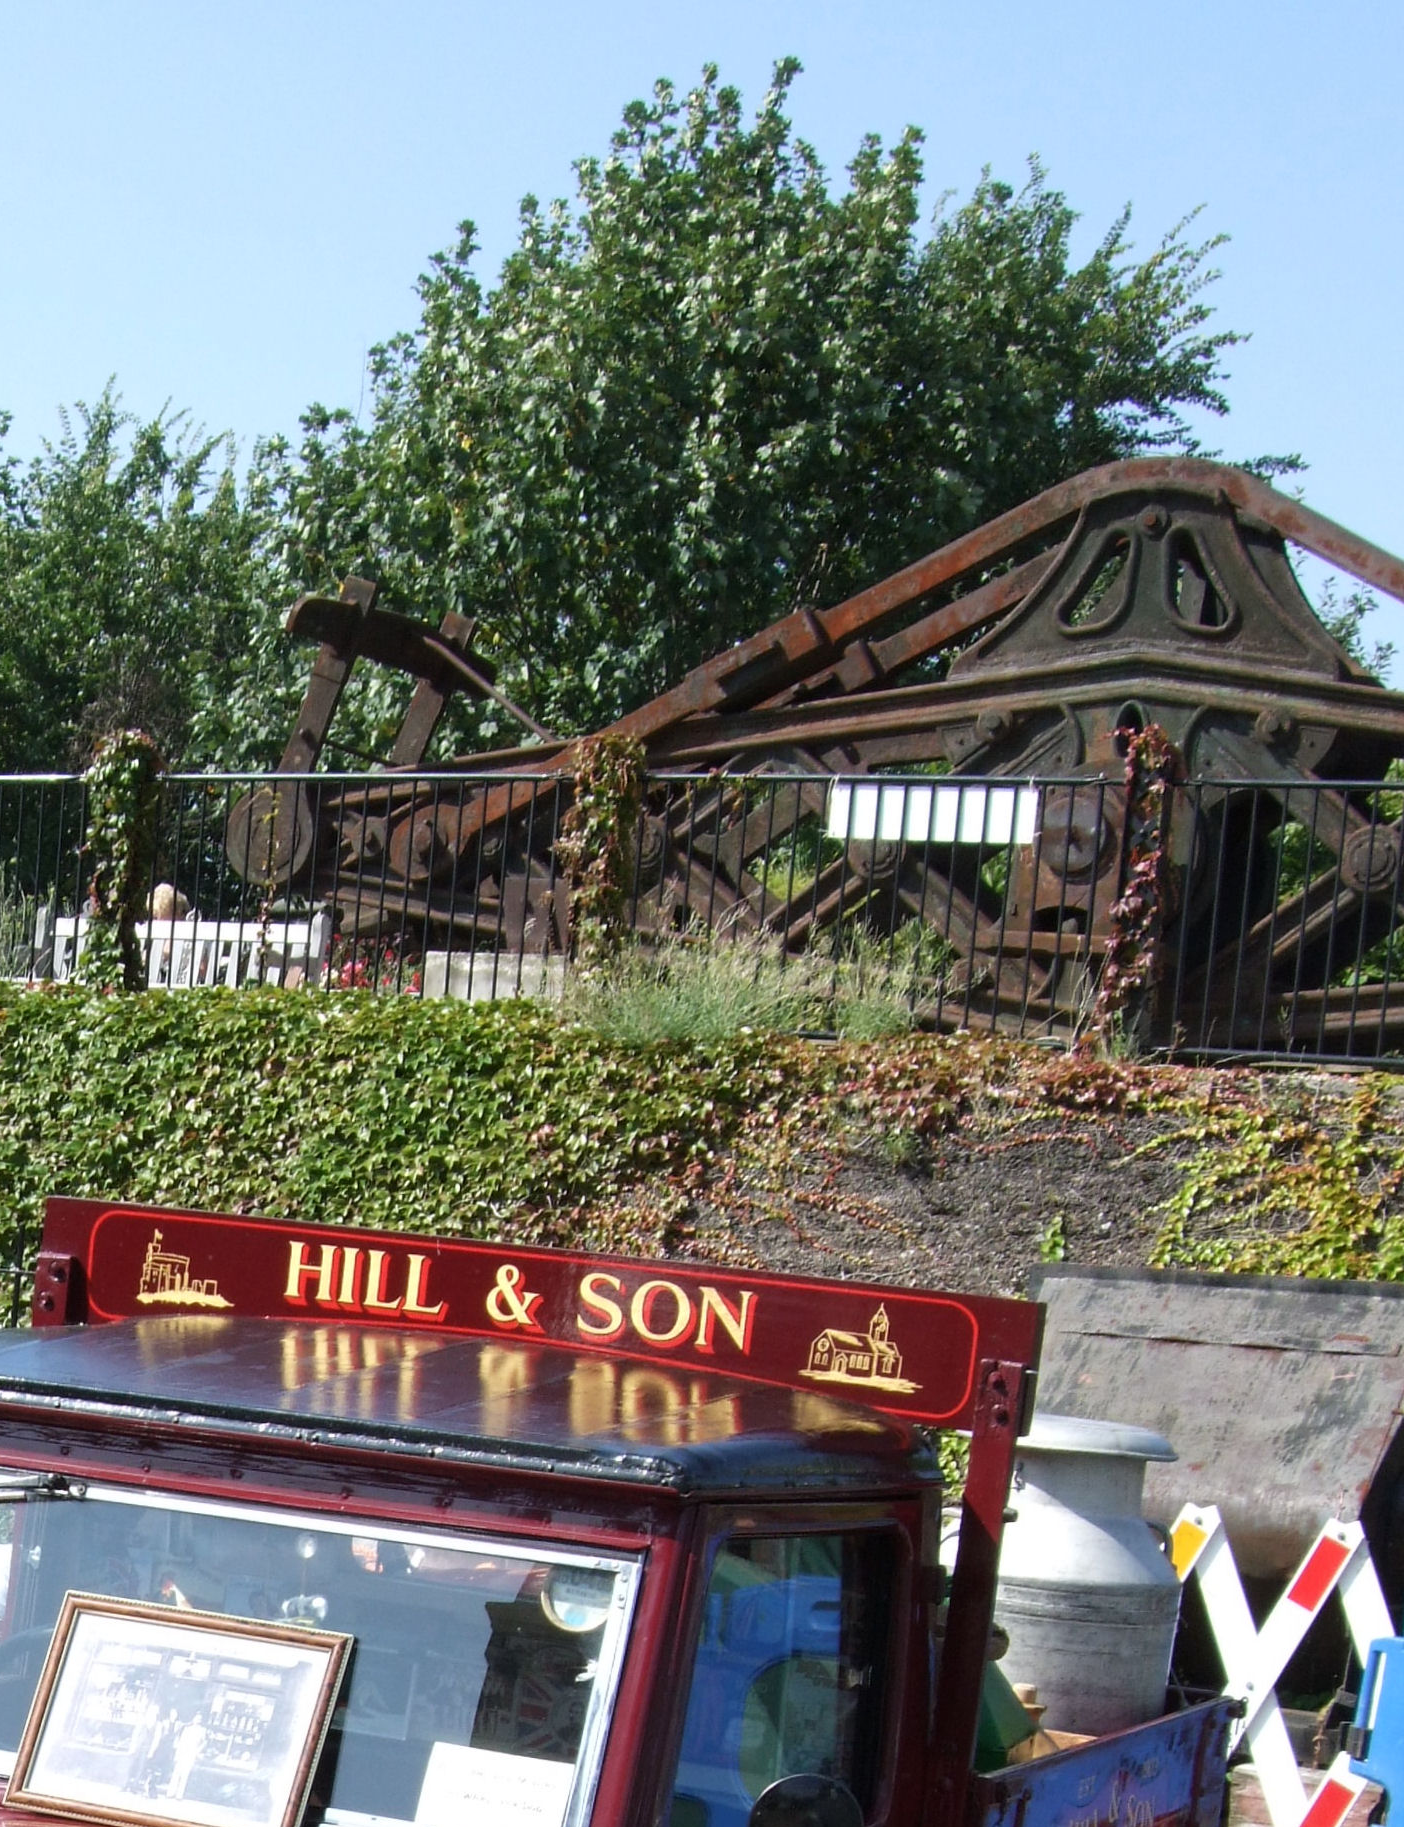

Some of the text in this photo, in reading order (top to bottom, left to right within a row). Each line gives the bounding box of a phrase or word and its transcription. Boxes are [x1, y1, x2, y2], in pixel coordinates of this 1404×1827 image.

[282, 1240, 758, 1356] HILL & SON
